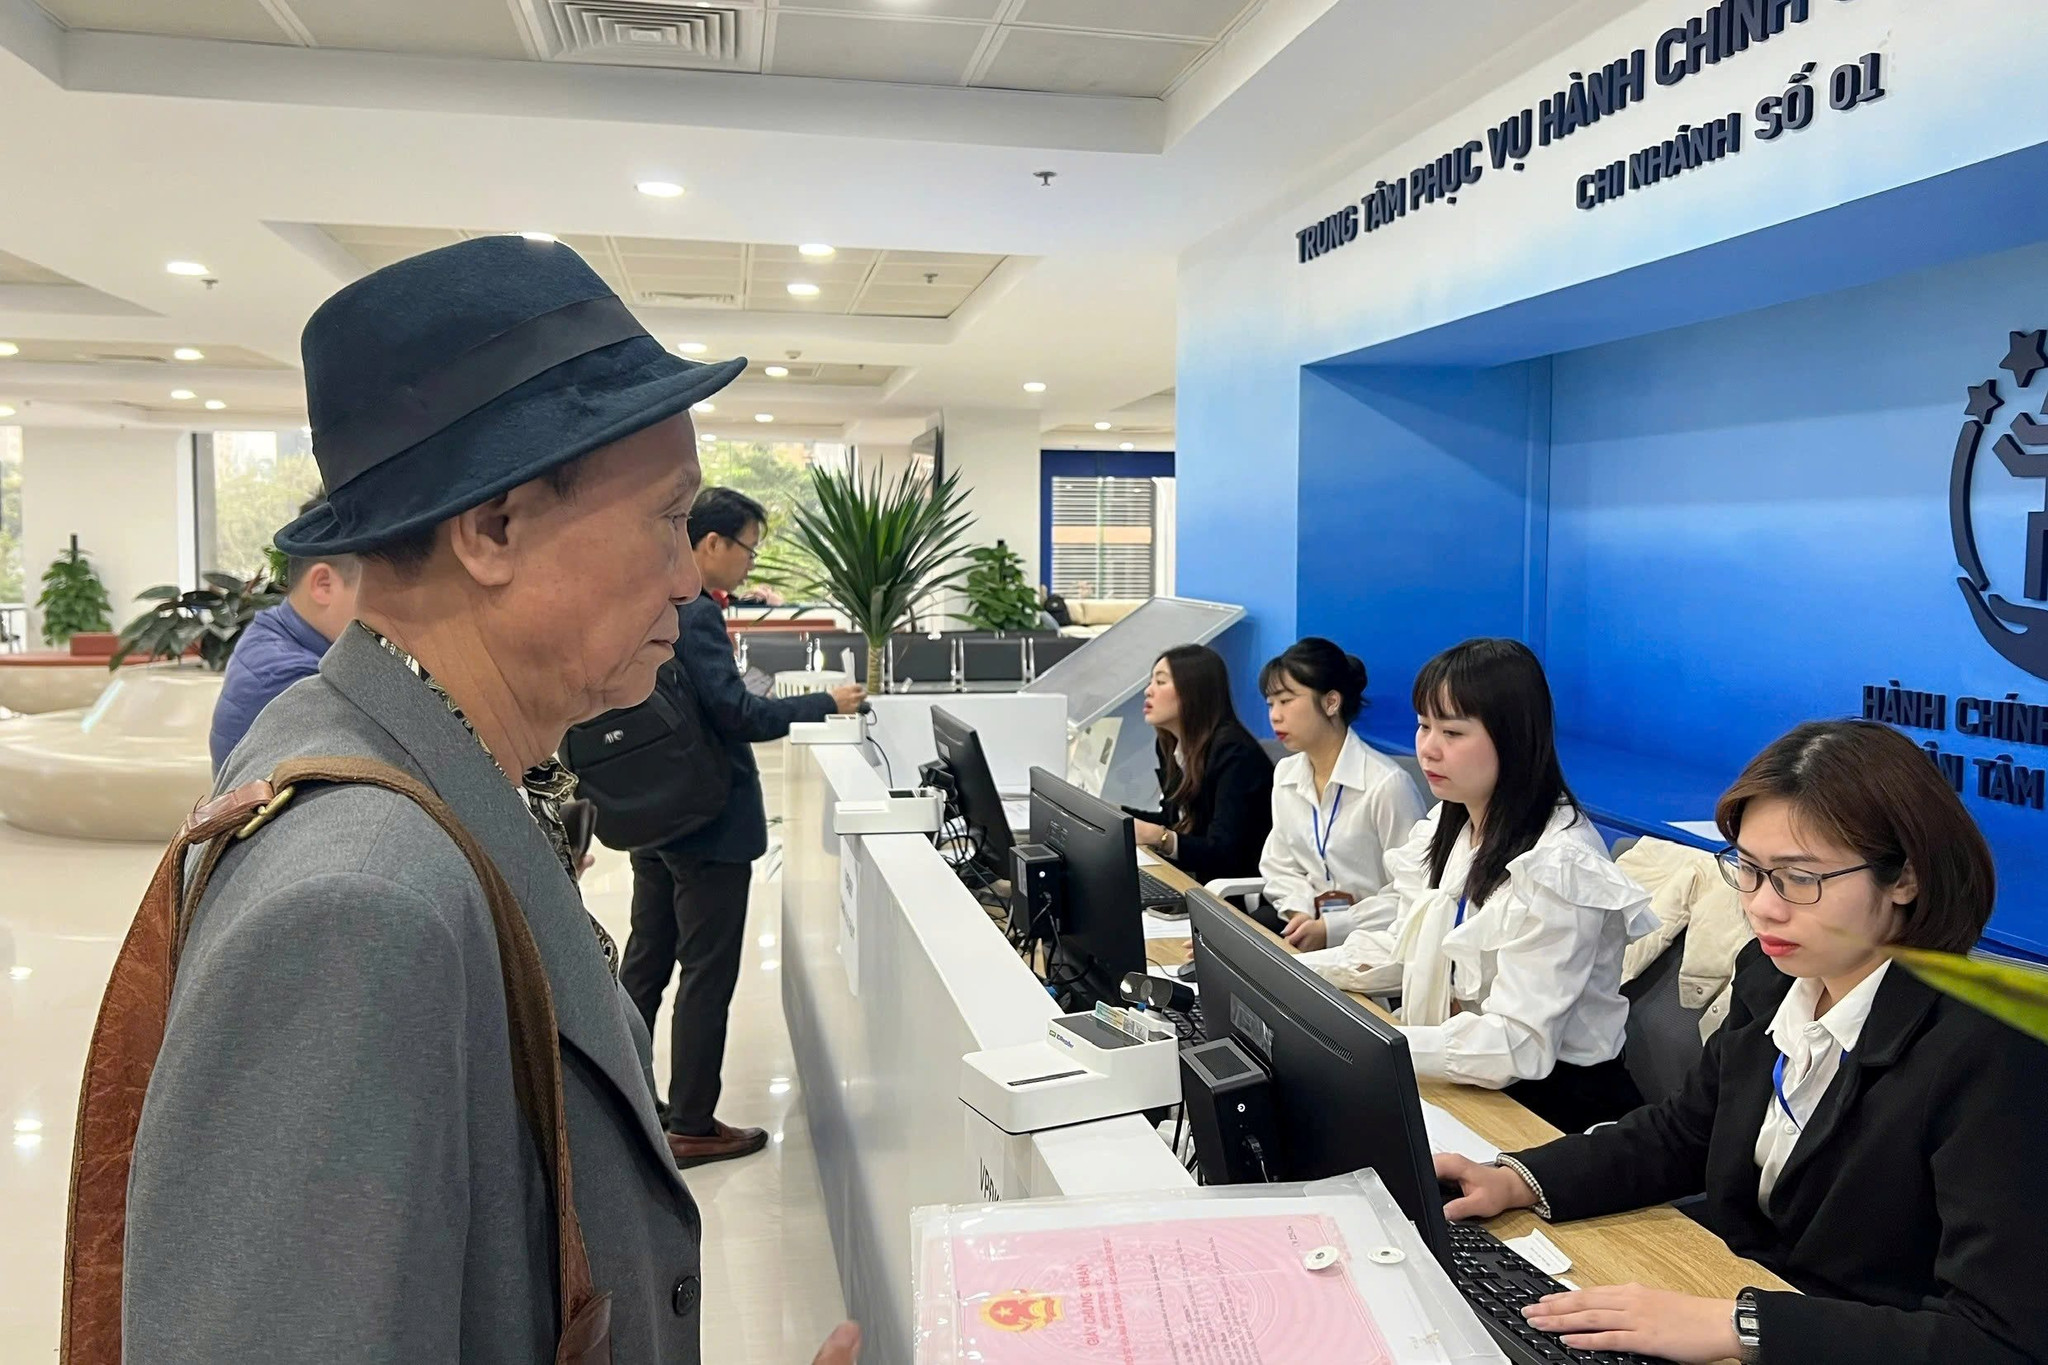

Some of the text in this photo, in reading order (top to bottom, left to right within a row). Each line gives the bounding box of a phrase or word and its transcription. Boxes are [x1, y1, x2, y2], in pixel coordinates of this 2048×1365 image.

[1296, 205, 1358, 263] TRUNG
[1361, 180, 1406, 232] TÂM
[1410, 140, 1483, 211] PHỤC
[1487, 109, 1532, 171] VỤ
[1539, 49, 1645, 146] HÀNH
[1576, 53, 1885, 210] CHI NHÁNH SỐ 01
[1863, 679, 1947, 730] HÀNH
[1972, 754, 2045, 809] TÂM
